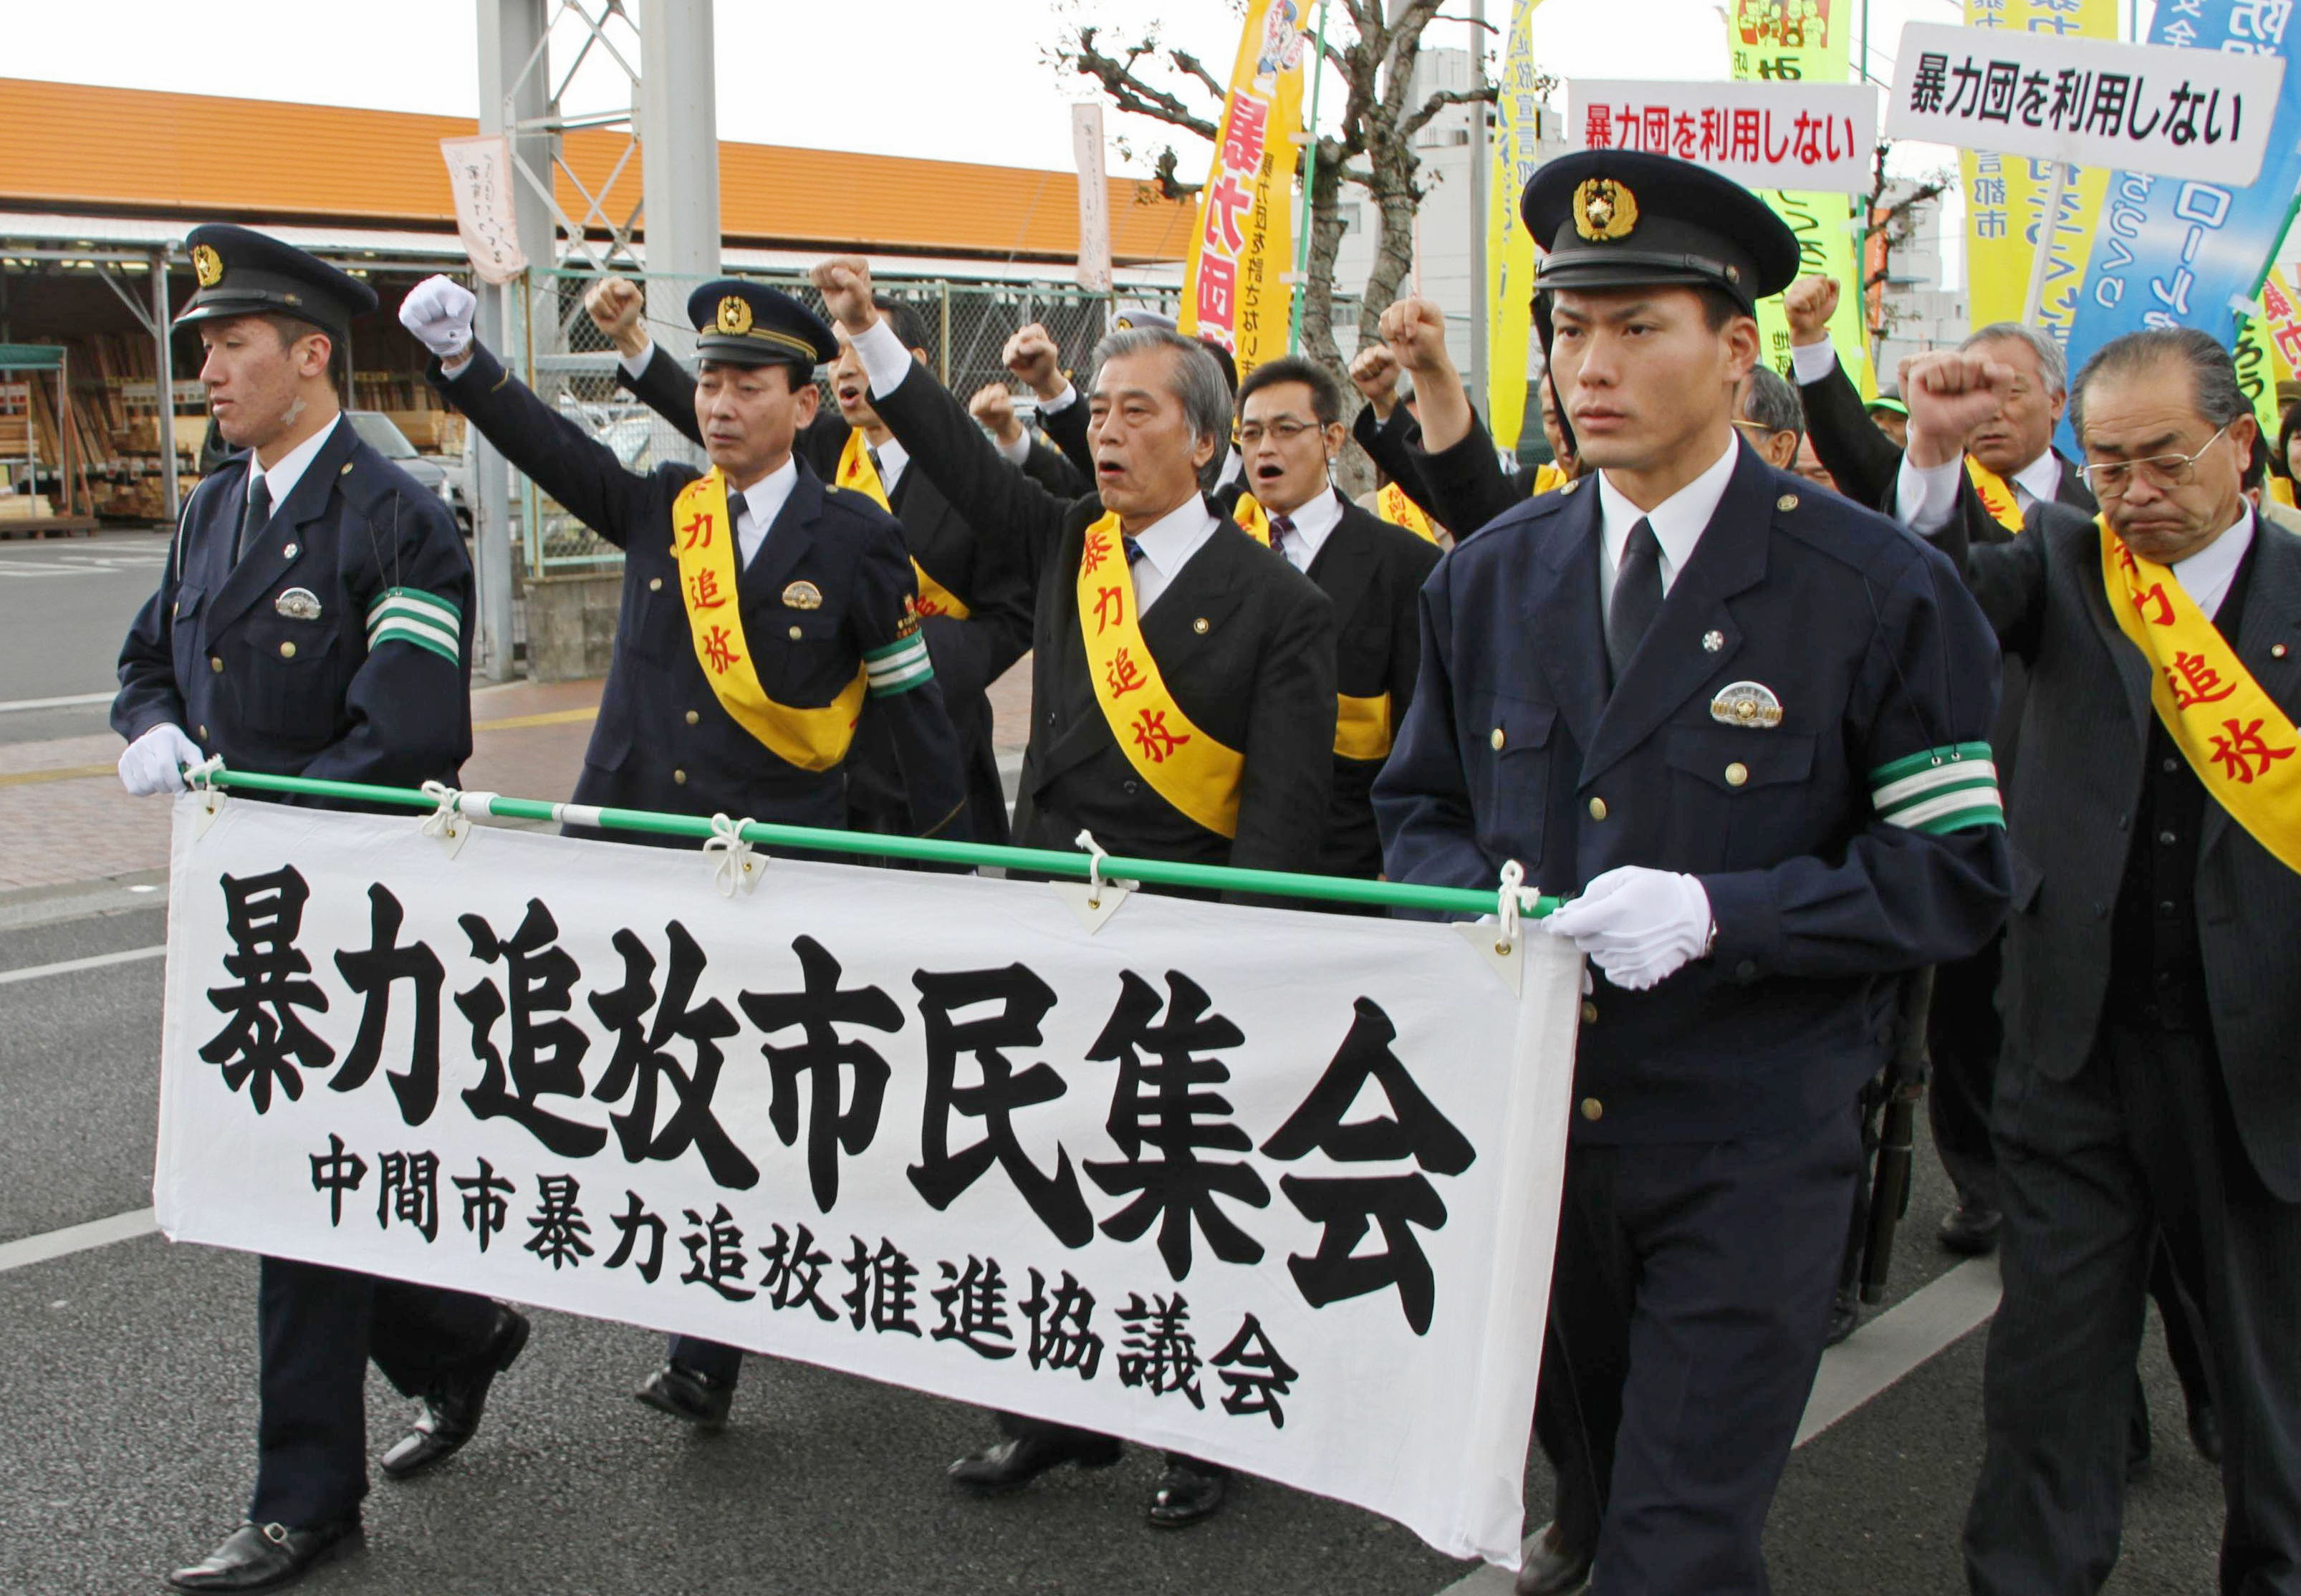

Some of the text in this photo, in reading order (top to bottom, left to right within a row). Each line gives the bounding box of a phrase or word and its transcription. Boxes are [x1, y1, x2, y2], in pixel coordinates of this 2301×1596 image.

[1585, 104, 1855, 166] 暴力団を利用しない
[1908, 52, 2242, 146] 暴力団を利用しない
[198, 865, 1476, 1336] 暴力追放市民集会
[309, 1133, 1299, 1429] 中間市暴力追放推進協議会
